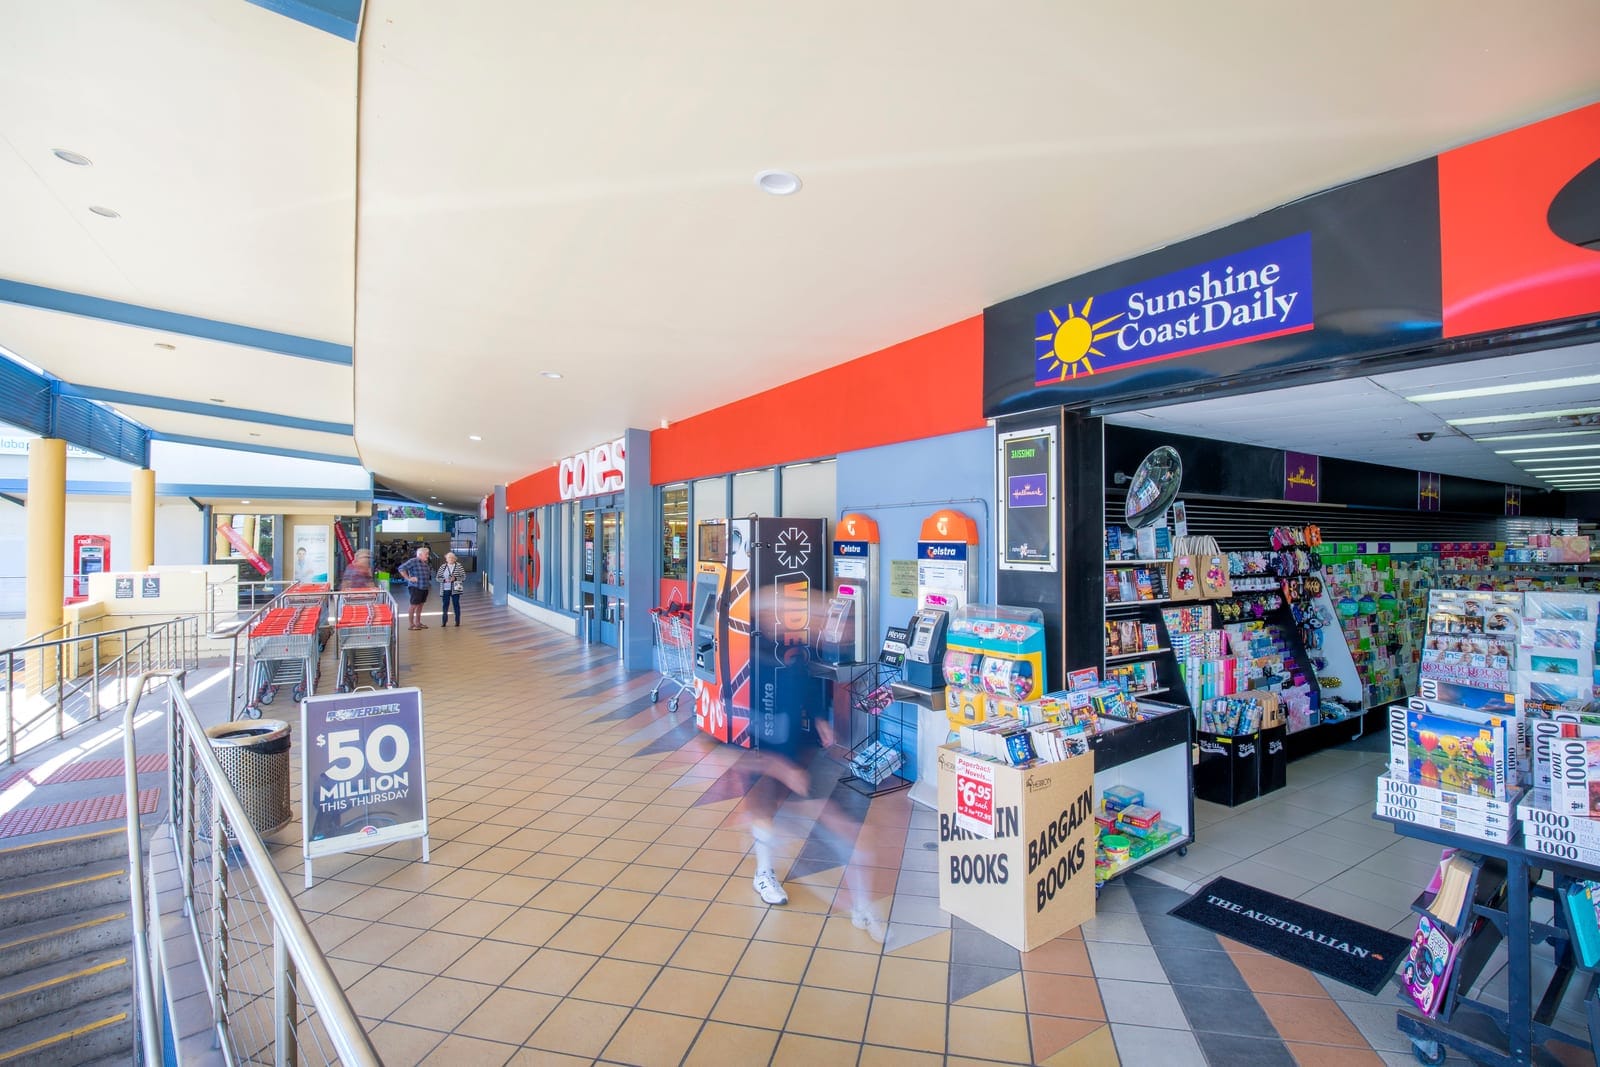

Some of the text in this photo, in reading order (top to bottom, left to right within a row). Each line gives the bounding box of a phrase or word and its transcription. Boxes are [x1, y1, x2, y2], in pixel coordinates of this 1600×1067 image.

[1127, 263, 1280, 321] Sunshine
[1117, 286, 1298, 351] Coast Daily
[559, 438, 625, 500] coles
[1012, 488, 1043, 499] Hallmark
[840, 544, 861, 554] Telstra
[927, 546, 956, 558] Telstra
[1422, 680, 1437, 700] 00
[326, 703, 400, 722] POWERBALL
[762, 683, 774, 736] express
[1391, 709, 1406, 749] 1000
[1517, 722, 1525, 744] 1000
[316, 724, 410, 781] $50
[1507, 747, 1516, 770] 1000
[1552, 751, 1562, 779] 1000
[958, 758, 991, 773] Paperback
[1496, 760, 1504, 785] 1000
[1565, 742, 1587, 790] 1000
[320, 772, 409, 802] MILLION
[958, 778, 992, 807] $6.95
[1385, 780, 1418, 796] 1000
[320, 788, 409, 813] THIS THURSDAY
[1384, 792, 1417, 809] 1000
[940, 806, 1019, 842] BAIN
[1383, 805, 1416, 822] 1000
[1528, 809, 1569, 829] 1000
[1029, 785, 1093, 875] BARGAIN
[1534, 824, 1575, 844] 1000
[1535, 839, 1578, 860] 1000
[950, 853, 1008, 884] BOOKS
[1036, 837, 1085, 913] BOOKS
[1208, 895, 1370, 958] THE AUSTRALIAN
